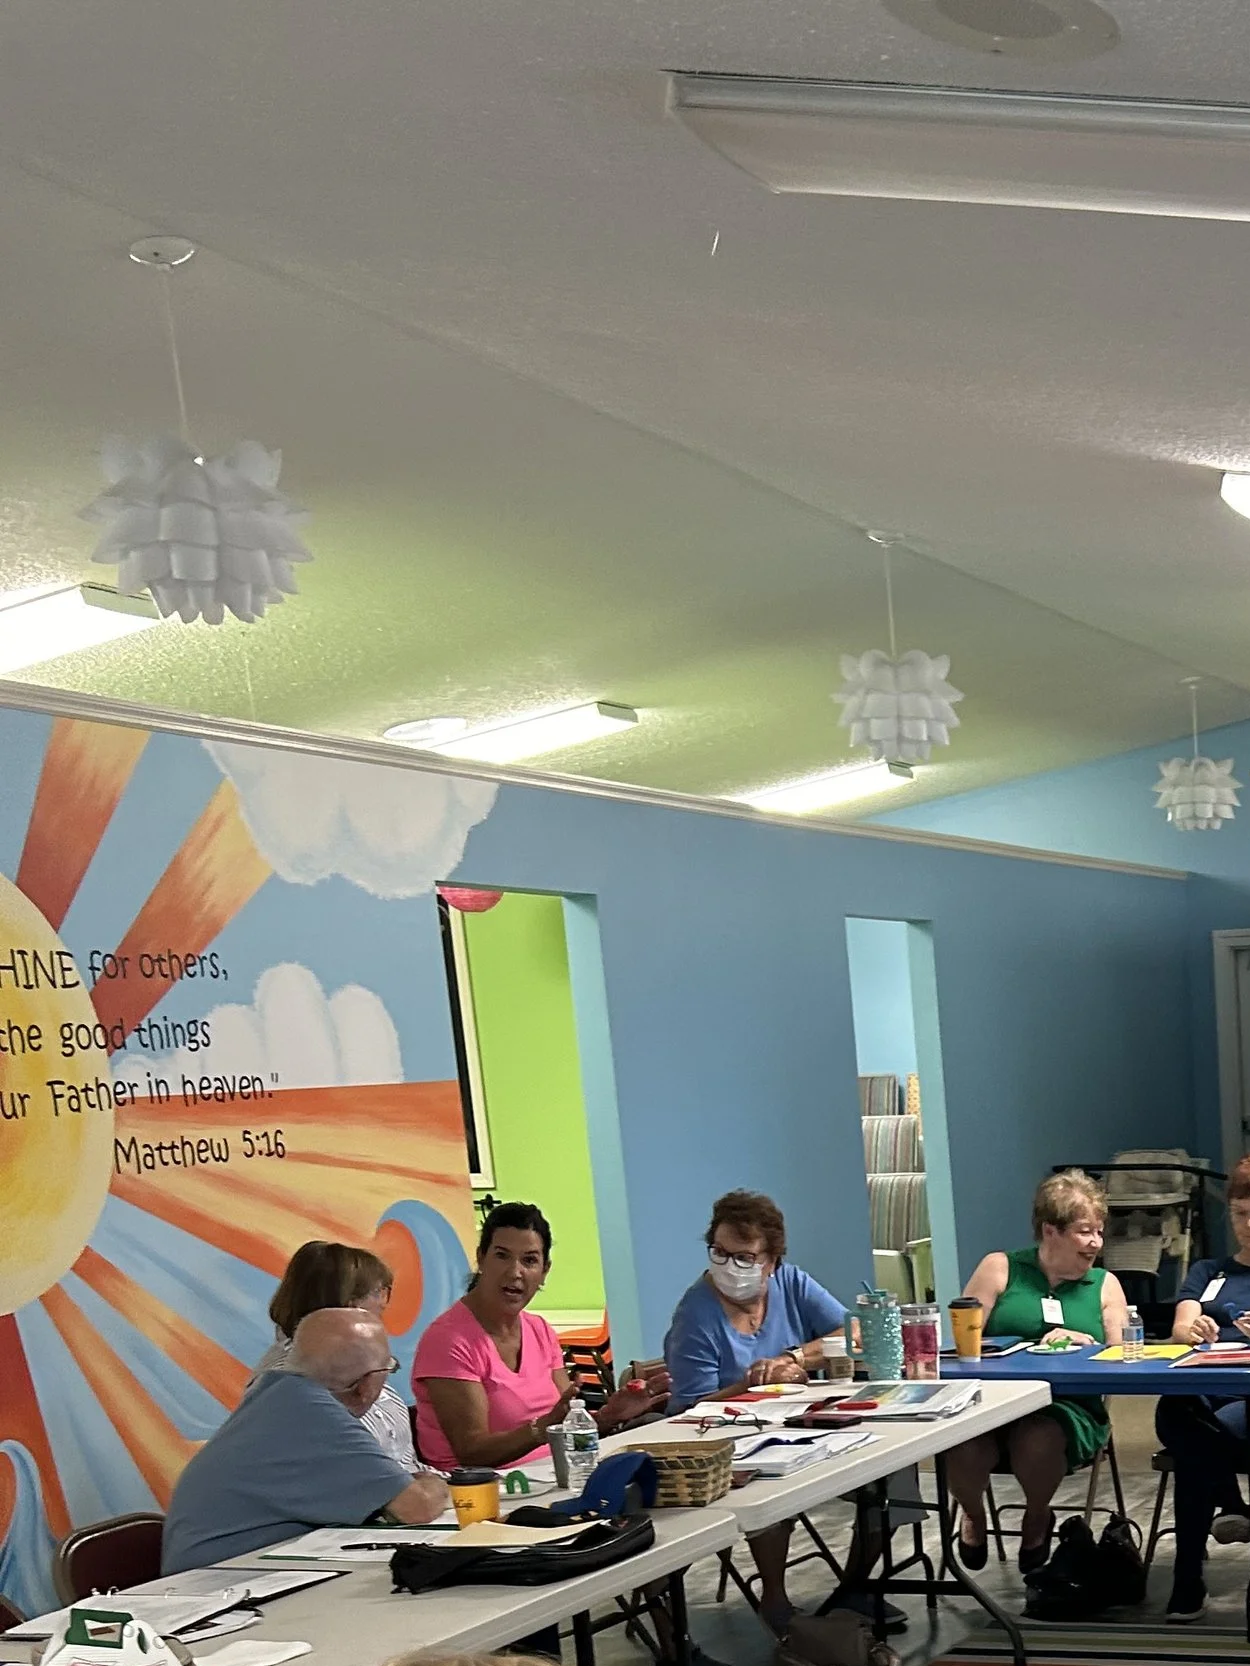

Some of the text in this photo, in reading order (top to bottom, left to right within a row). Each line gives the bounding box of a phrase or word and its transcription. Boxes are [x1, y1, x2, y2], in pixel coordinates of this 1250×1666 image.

[88, 950, 130, 986] for
[140, 948, 229, 980] others,
[60, 1019, 127, 1058] good
[134, 1016, 211, 1053] things
[46, 1075, 138, 1117] Father
[146, 1072, 171, 1105] in
[182, 1072, 280, 1107] heaven."
[113, 1129, 286, 1175] Matthew 5:16
